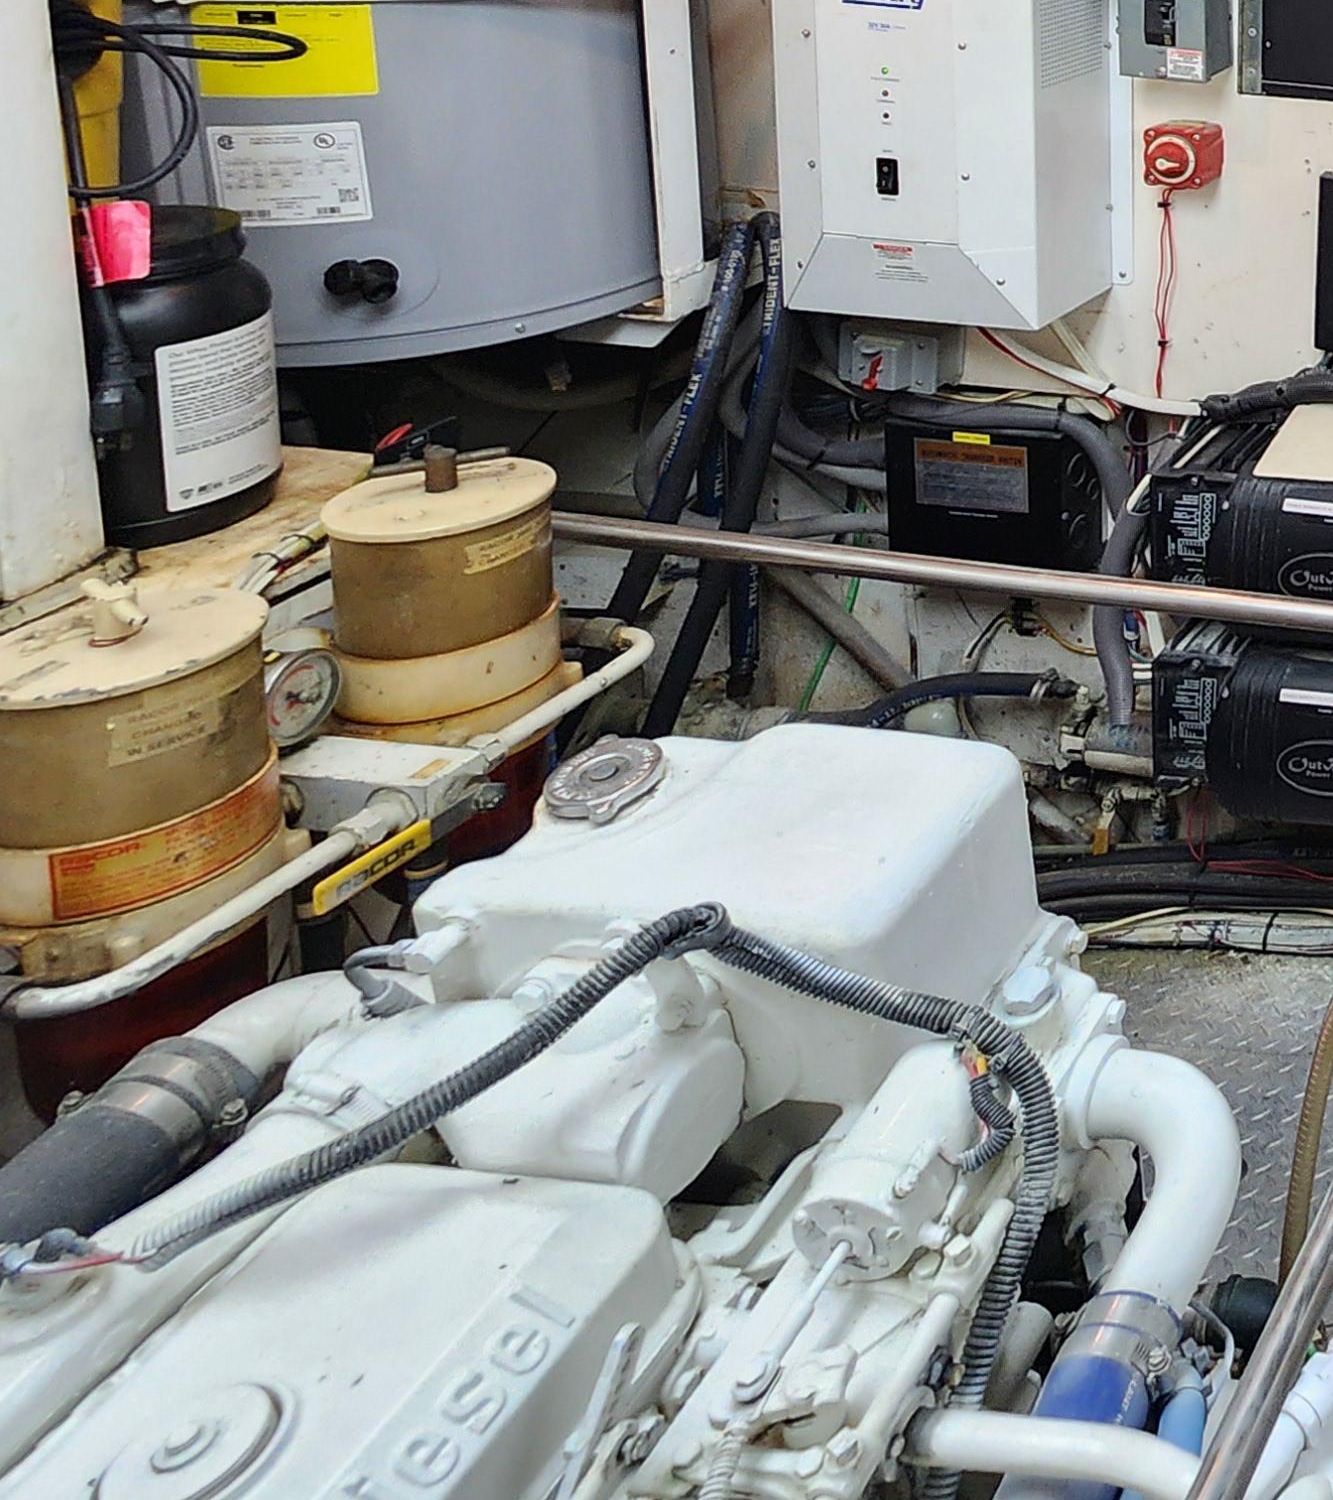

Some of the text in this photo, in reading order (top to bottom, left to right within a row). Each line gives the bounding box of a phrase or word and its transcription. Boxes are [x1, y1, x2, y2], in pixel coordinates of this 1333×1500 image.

[663, 372, 703, 474] TRIDENT-FLEX
[1307, 583, 1333, 592] Power
[1305, 769, 1331, 779] Power
